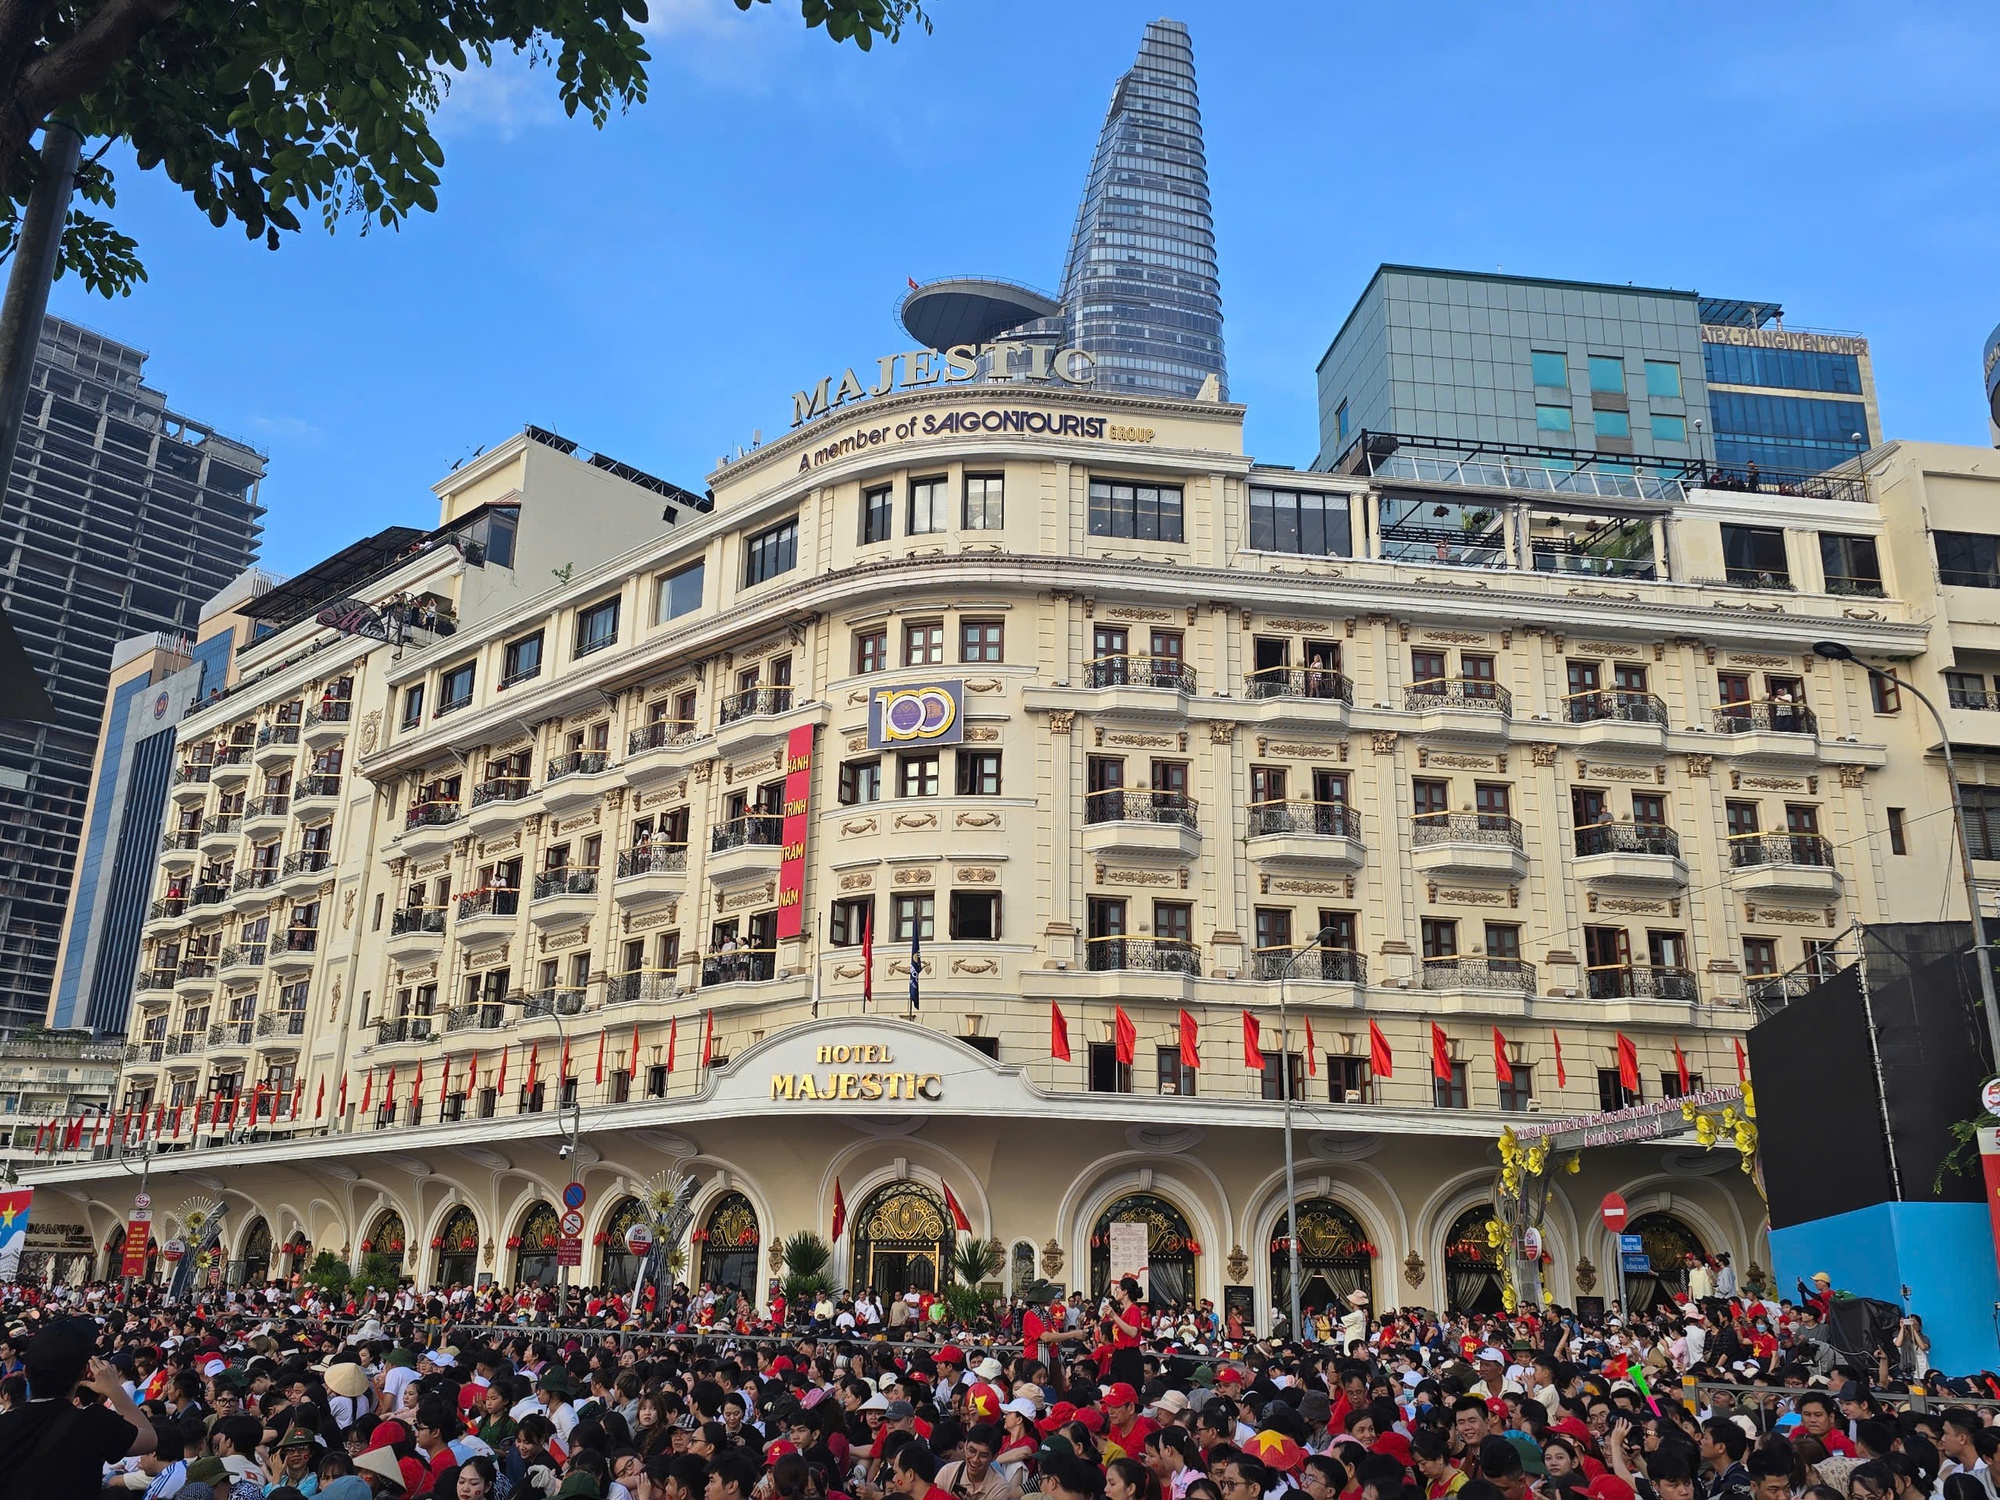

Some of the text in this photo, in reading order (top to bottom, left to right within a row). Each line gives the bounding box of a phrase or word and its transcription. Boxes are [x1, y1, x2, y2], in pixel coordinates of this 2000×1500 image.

[1701, 325, 1732, 344] ATEX
[1820, 335, 1868, 357] TOWER
[790, 343, 1096, 428] MAJESTIC
[798, 410, 1155, 473] A member of SAIGONTOURIST GROUP
[874, 686, 956, 743] 100
[783, 798, 807, 818] TRÌNH
[781, 841, 805, 863] TRĂM
[779, 887, 800, 908] NĂM
[816, 1044, 893, 1064] HOTEL
[770, 1072, 943, 1101] MAJESTIC
